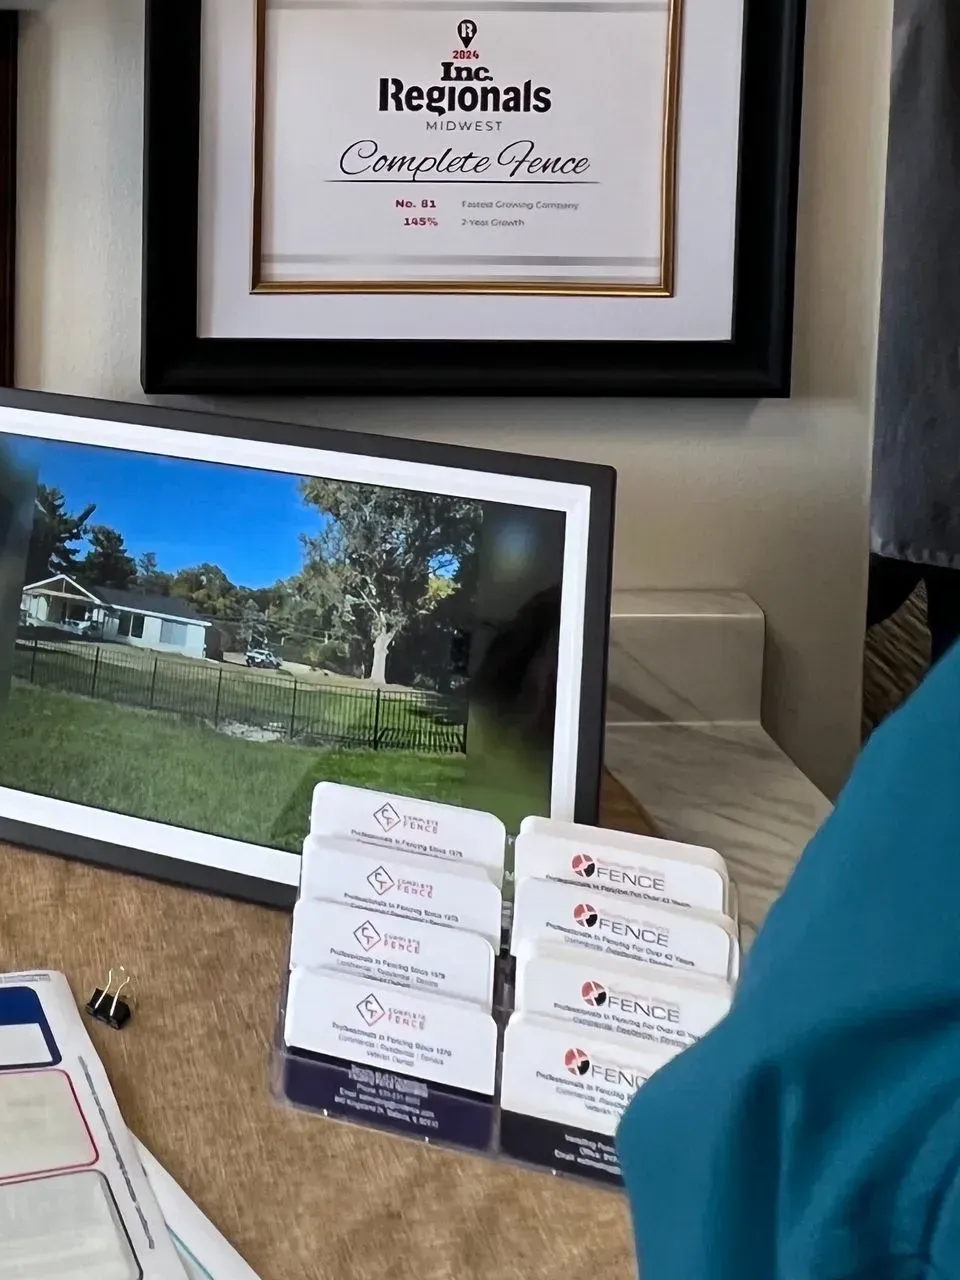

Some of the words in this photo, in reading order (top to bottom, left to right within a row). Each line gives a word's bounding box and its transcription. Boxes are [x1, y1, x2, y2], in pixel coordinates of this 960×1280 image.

[452, 50, 480, 60] 2024
[440, 61, 494, 82] Inc.
[379, 77, 552, 117] Regionals
[425, 120, 503, 132] MIDWEST
[340, 139, 492, 181] Complete
[497, 139, 591, 178] Fence
[395, 199, 417, 209] No.
[461, 200, 493, 209] Fastest
[495, 201, 534, 210] Growing
[535, 201, 579, 211] Company
[491, 218, 525, 227] Growth
[596, 867, 665, 891] FENCE
[599, 918, 670, 948] FENCE
[608, 996, 680, 1024] FENCE
[591, 1064, 647, 1089] FENC
